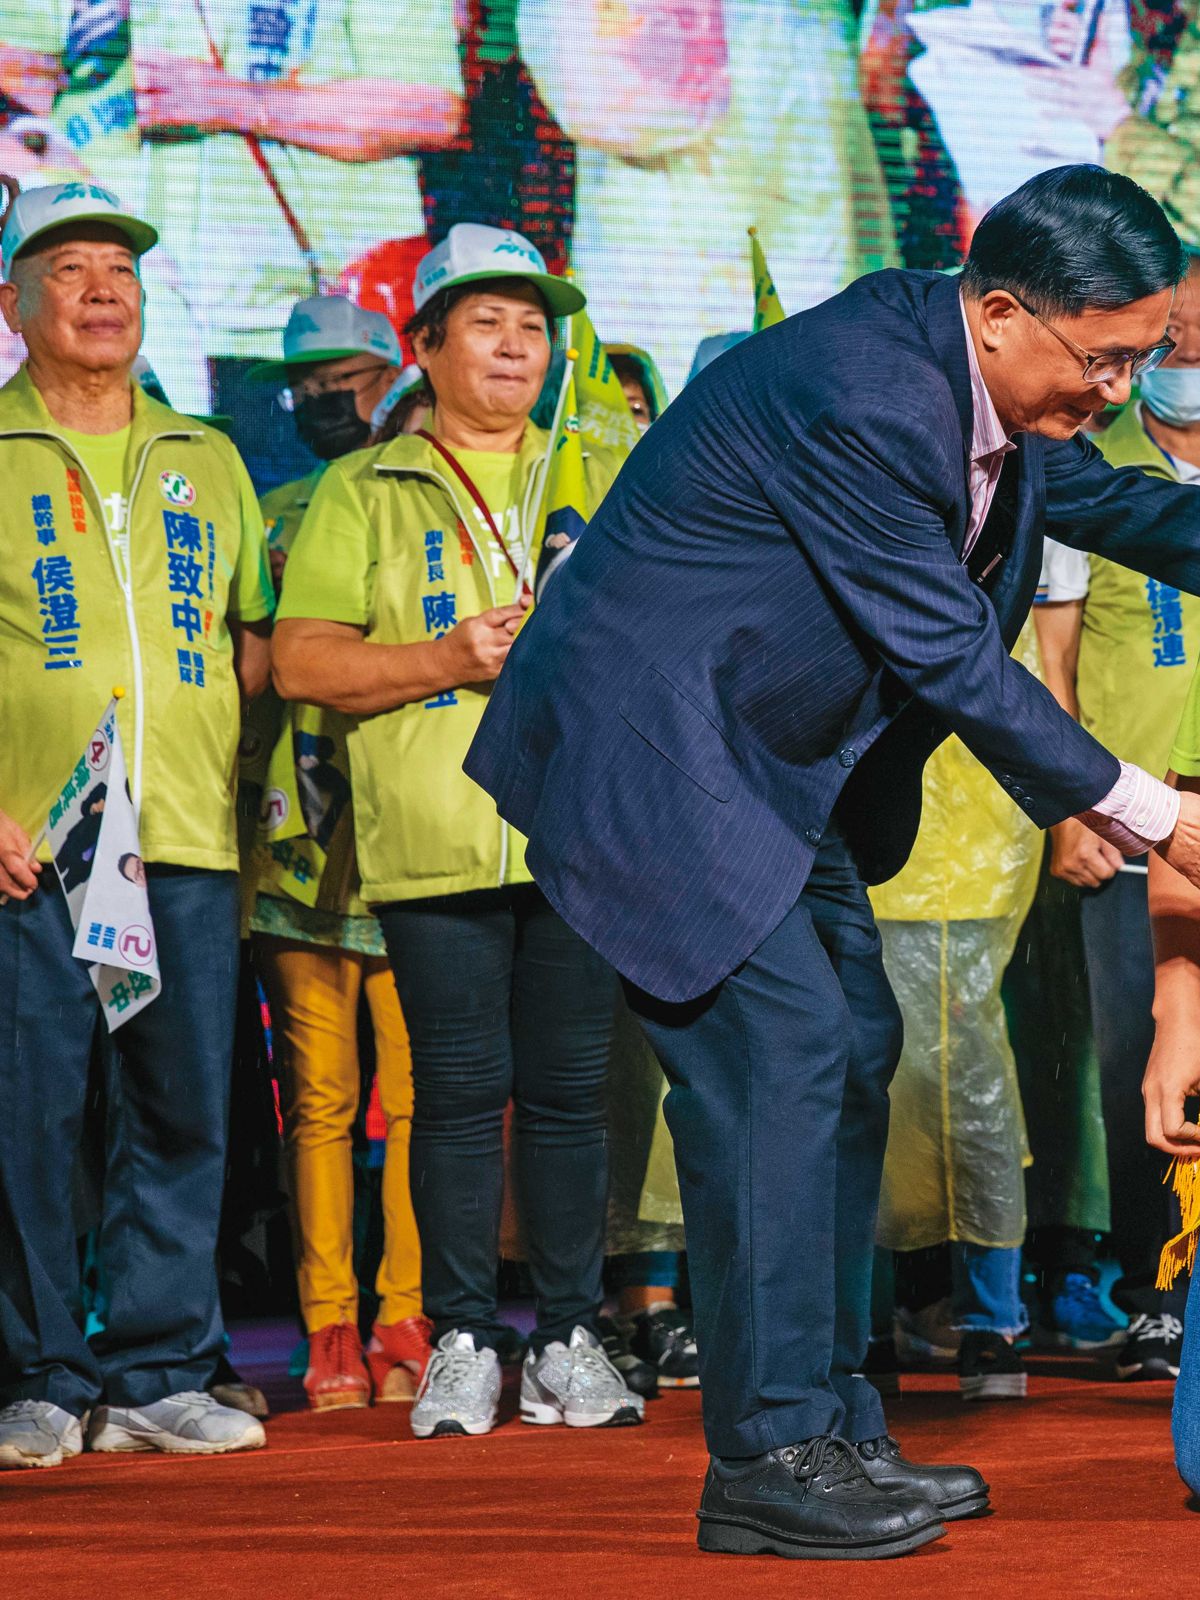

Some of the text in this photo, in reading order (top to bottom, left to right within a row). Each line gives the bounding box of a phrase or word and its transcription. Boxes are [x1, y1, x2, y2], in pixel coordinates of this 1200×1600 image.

[162, 510, 205, 642] 陳致中
[424, 530, 445, 583] 副會長
[30, 555, 83, 670] 侯澄三
[90, 740, 106, 763] 4
